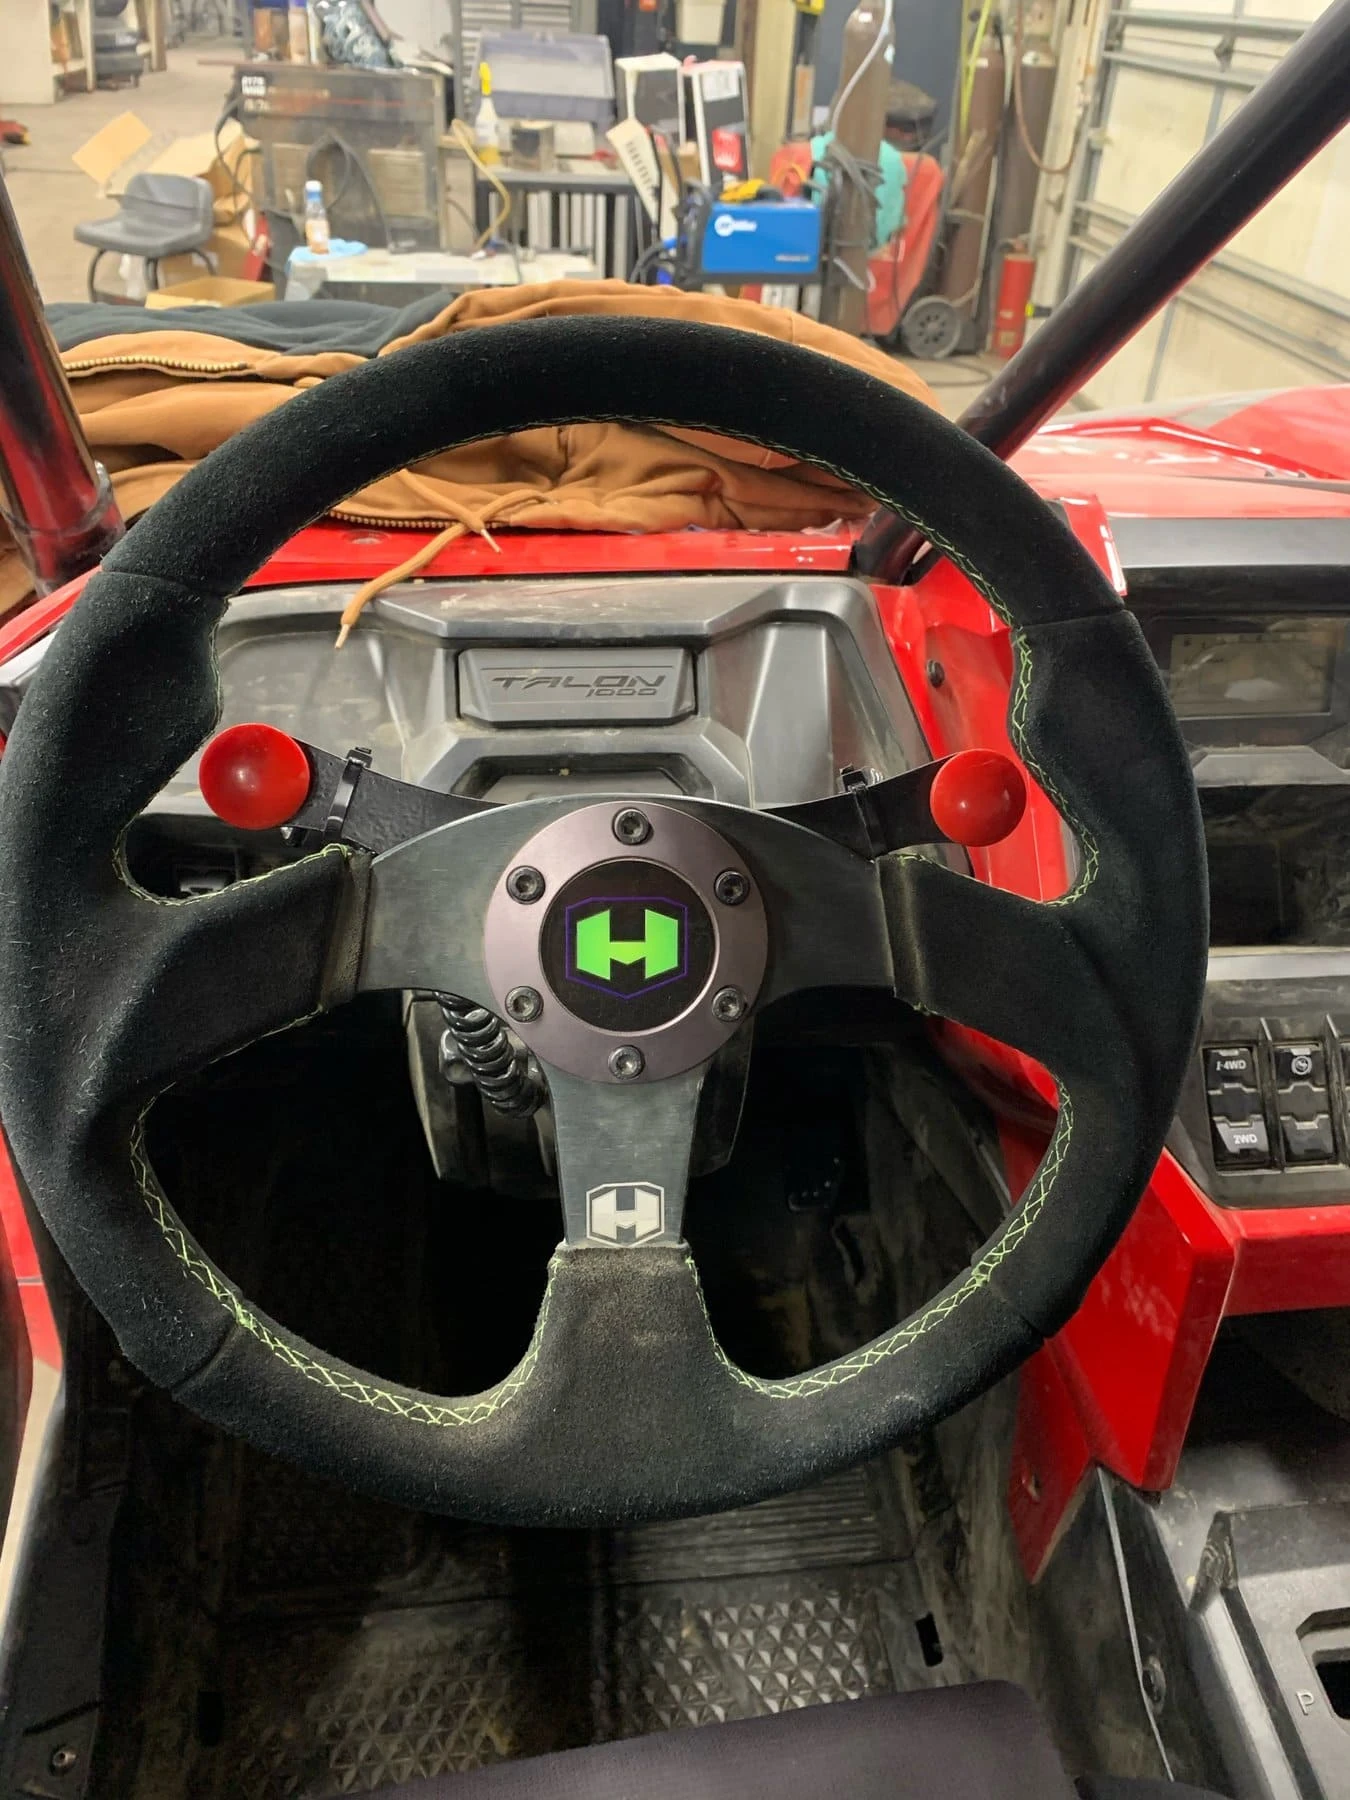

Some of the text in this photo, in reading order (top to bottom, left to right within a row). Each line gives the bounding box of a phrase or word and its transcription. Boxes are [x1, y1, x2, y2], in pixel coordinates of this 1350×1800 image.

[492, 675, 666, 690] TALON
[585, 688, 657, 698] 1000
[1232, 1133, 1258, 1145] 2WD
[1295, 1690, 1315, 1716] P
